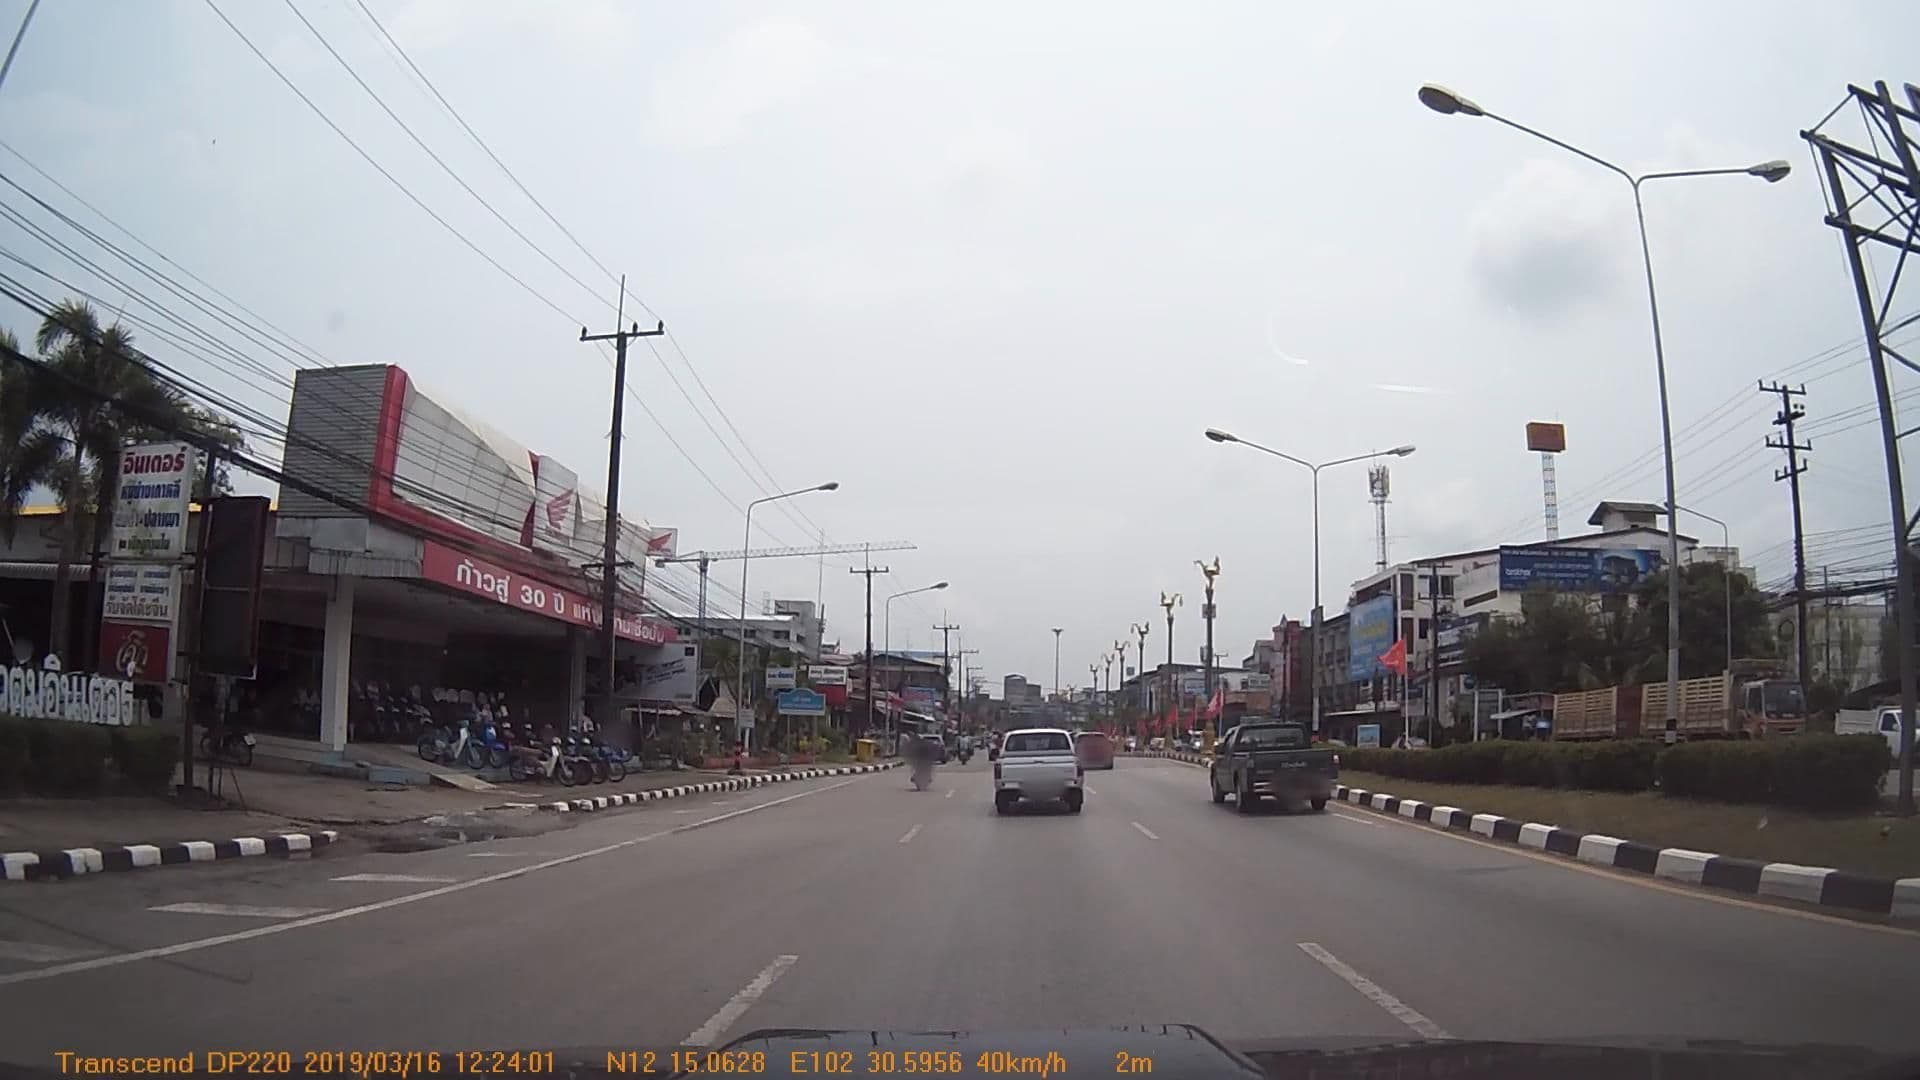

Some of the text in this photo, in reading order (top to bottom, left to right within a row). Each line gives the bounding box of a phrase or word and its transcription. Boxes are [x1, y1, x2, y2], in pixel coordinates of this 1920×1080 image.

[456, 558, 511, 603] ก้าวสู่
[520, 584, 546, 608] 30
[553, 591, 565, 614] ปี
